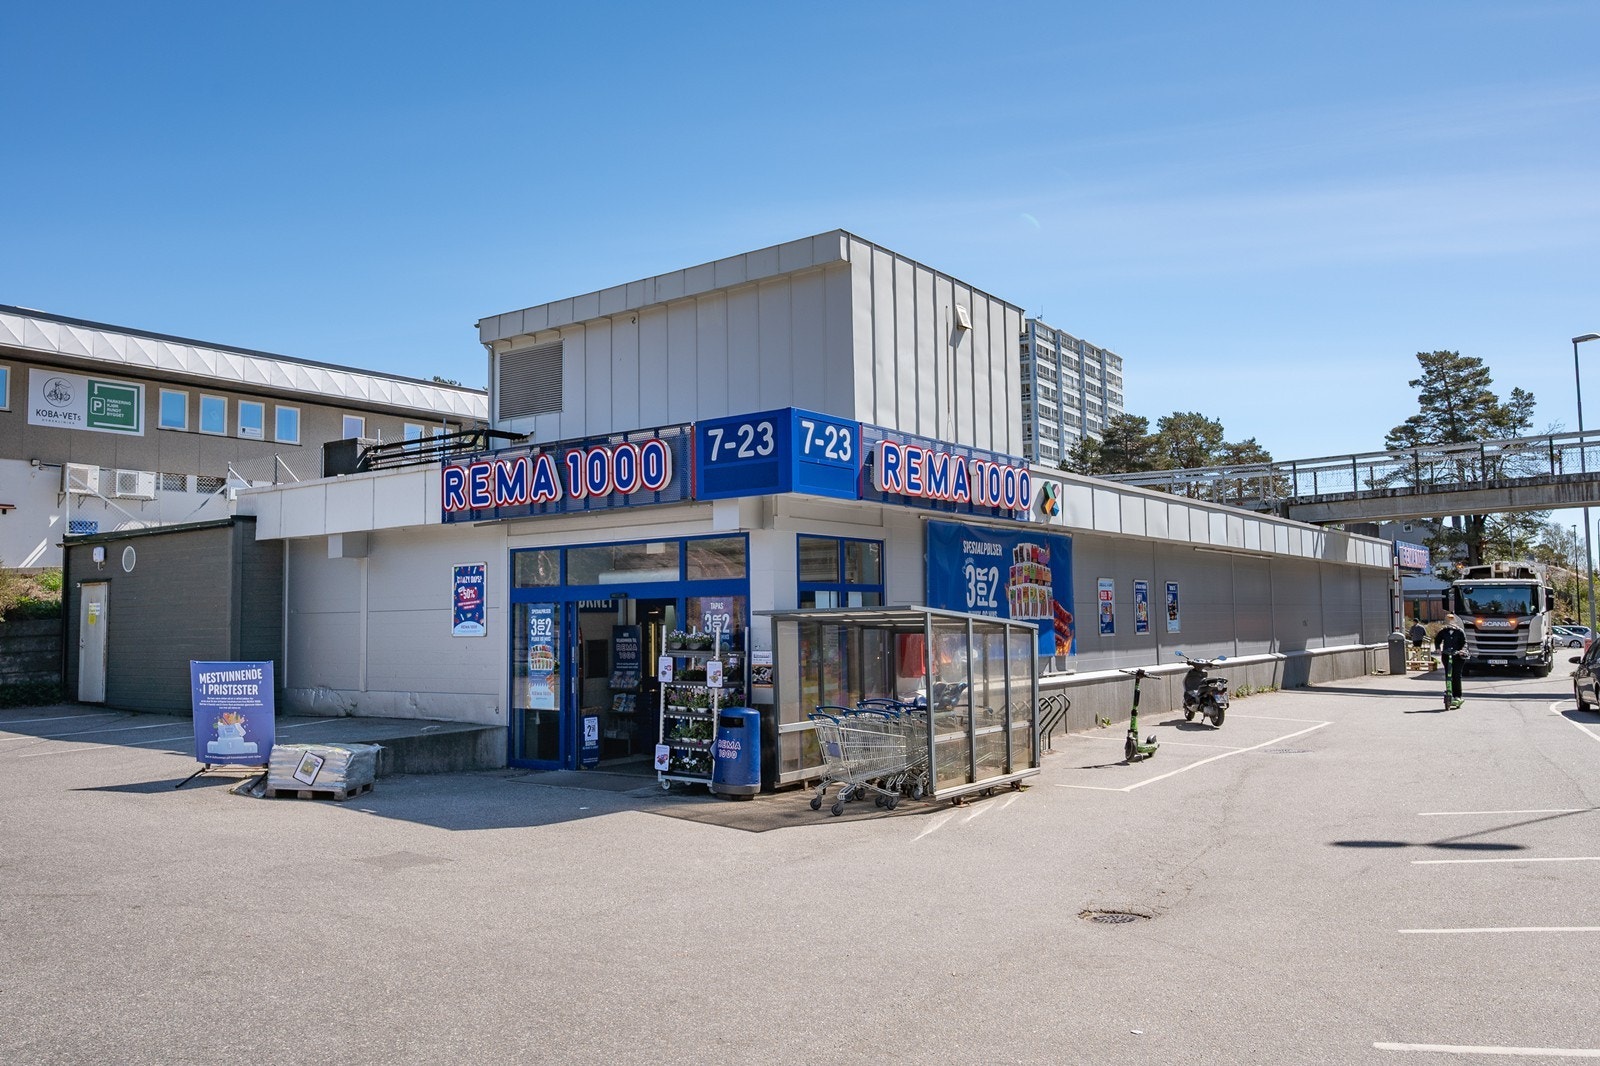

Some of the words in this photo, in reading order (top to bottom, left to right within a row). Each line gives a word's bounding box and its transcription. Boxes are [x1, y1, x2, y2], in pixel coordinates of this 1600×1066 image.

[94, 400, 102, 412] P
[708, 421, 774, 462] 7-23
[802, 420, 852, 462] 7-23
[442, 453, 560, 512] REMA
[566, 438, 671, 499] 1000
[876, 439, 970, 503] REMA
[970, 459, 1031, 512] 1000
[963, 540, 1002, 556] SPESIALPØLSER
[966, 564, 976, 608] 3
[976, 568, 988, 606] FOR
[988, 566, 998, 608] 2
[531, 618, 537, 636] 3
[537, 618, 545, 635] FOR
[545, 618, 552, 635] 2
[704, 614, 712, 633] 3
[722, 613, 730, 633] 2
[616, 644, 638, 652] REMA
[200, 668, 262, 684] MESTVINNENDE
[203, 684, 206, 695] I
[208, 684, 258, 695] PRISTESTER
[718, 740, 741, 750] REMA
[719, 750, 737, 759] 1000
